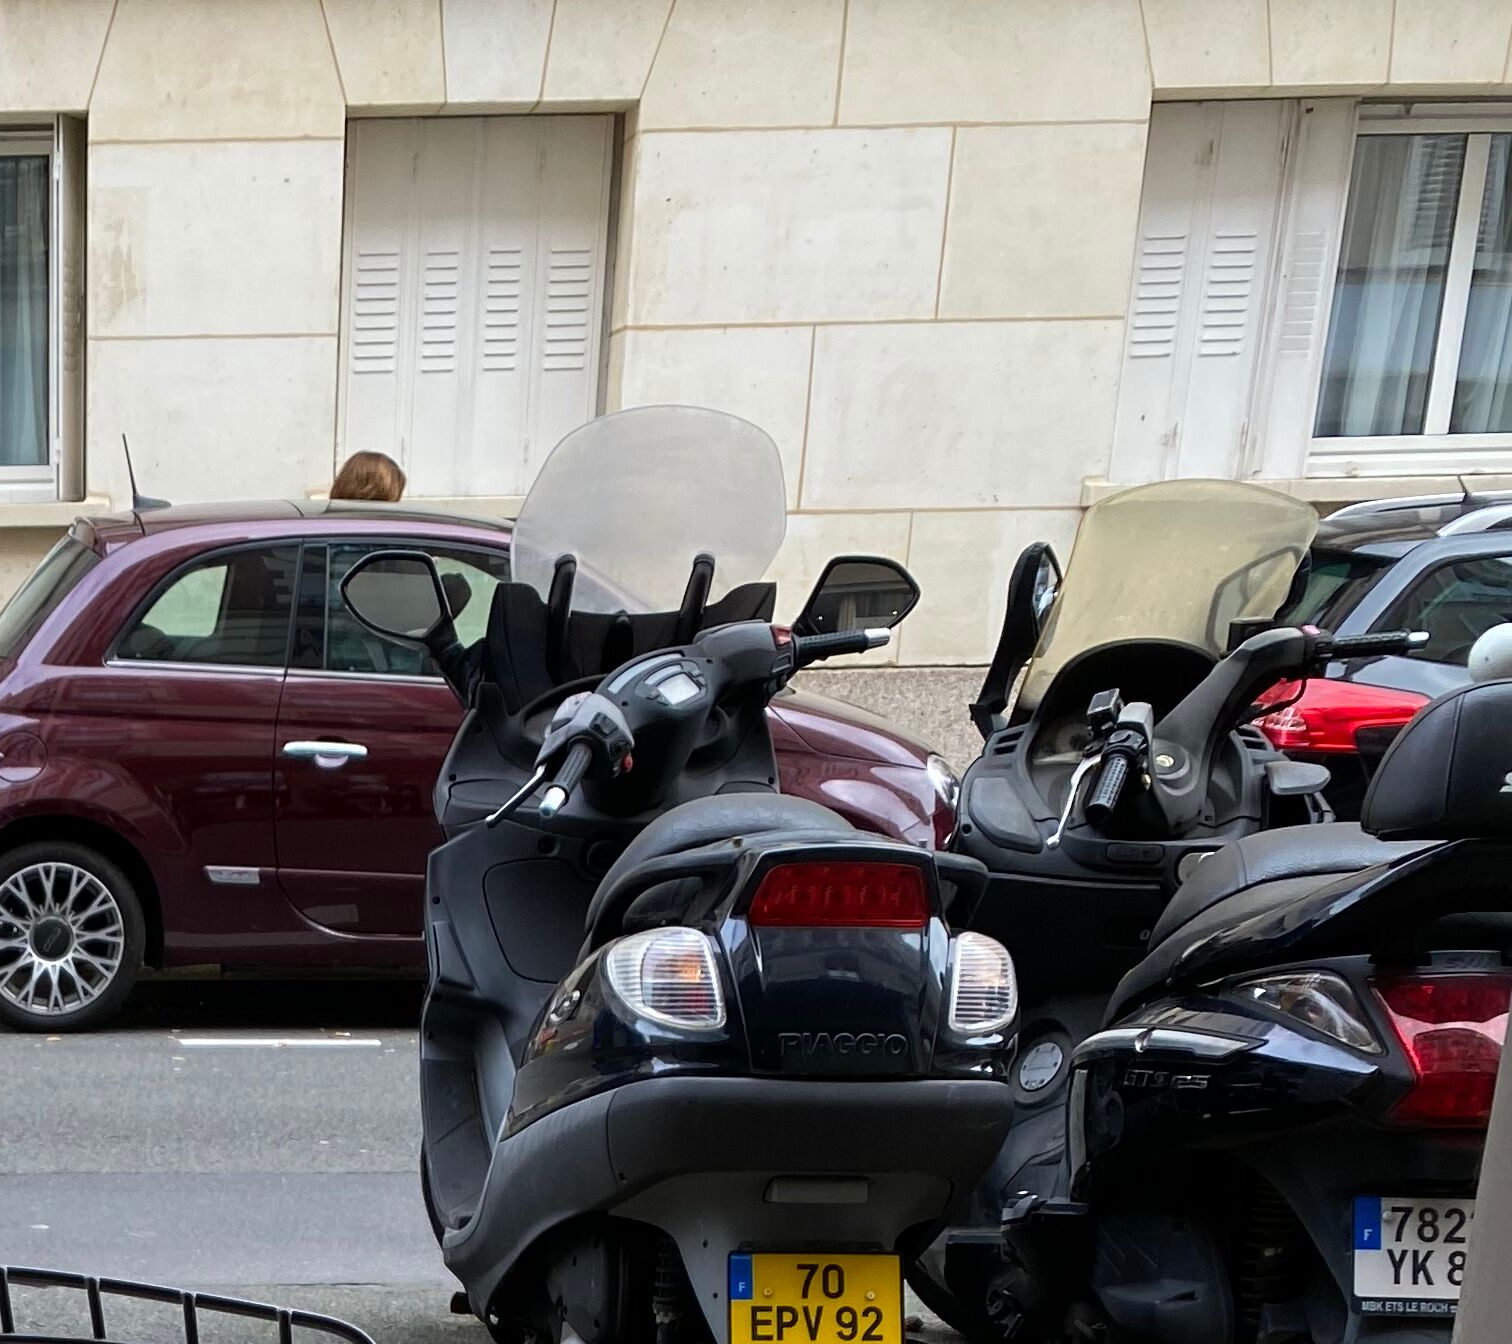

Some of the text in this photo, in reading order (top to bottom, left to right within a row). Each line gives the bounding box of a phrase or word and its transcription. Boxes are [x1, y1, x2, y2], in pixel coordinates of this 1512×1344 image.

[777, 1032, 907, 1056] PIAGGIO
[1363, 1228, 1373, 1241] F
[1391, 1206, 1475, 1244] 782
[796, 1263, 845, 1300] 70
[1386, 1248, 1435, 1286] YK
[738, 1281, 746, 1293] F
[1361, 1301, 1448, 1314] MBK ETS LE ROCH
[751, 1305, 884, 1342] EPV 92
